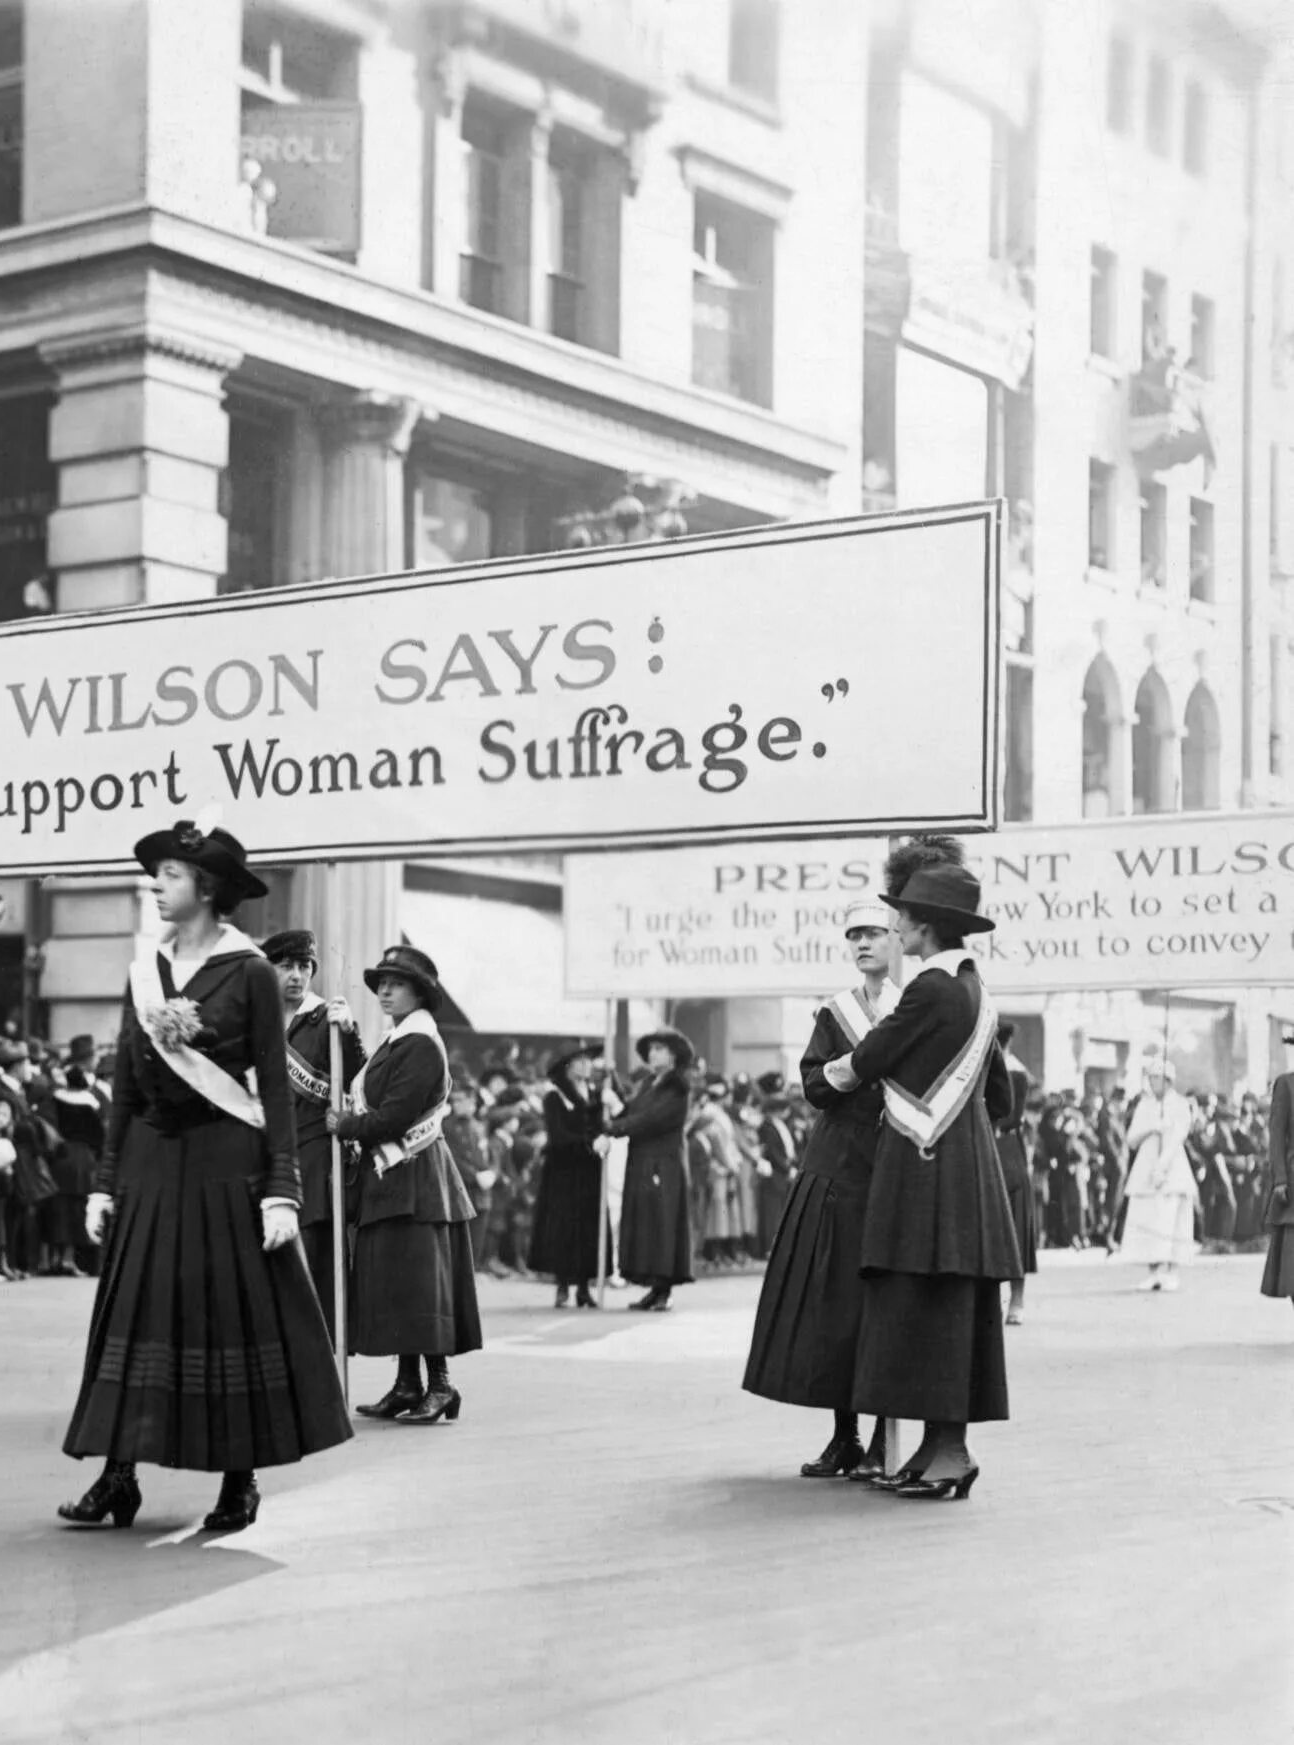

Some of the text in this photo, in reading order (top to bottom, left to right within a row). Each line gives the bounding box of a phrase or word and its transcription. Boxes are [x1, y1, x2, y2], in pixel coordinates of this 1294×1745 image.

[7, 651, 323, 738] WILSON
[214, 739, 446, 800] Woman
[477, 678, 849, 793] Suffrage.”
[715, 853, 1071, 894] PRESNT
[646, 907, 712, 934] urge
[732, 901, 777, 928] the
[794, 908, 847, 934] peo
[986, 902, 1027, 921] ew
[1037, 890, 1112, 920] York
[1130, 892, 1162, 917] to
[1183, 886, 1237, 914] set
[1258, 891, 1277, 913] a
[612, 939, 649, 967] for
[658, 937, 758, 965] Woman
[971, 933, 1007, 960] sk
[1023, 937, 1080, 966] you
[1097, 932, 1130, 957] to
[1146, 931, 1270, 962] convey
